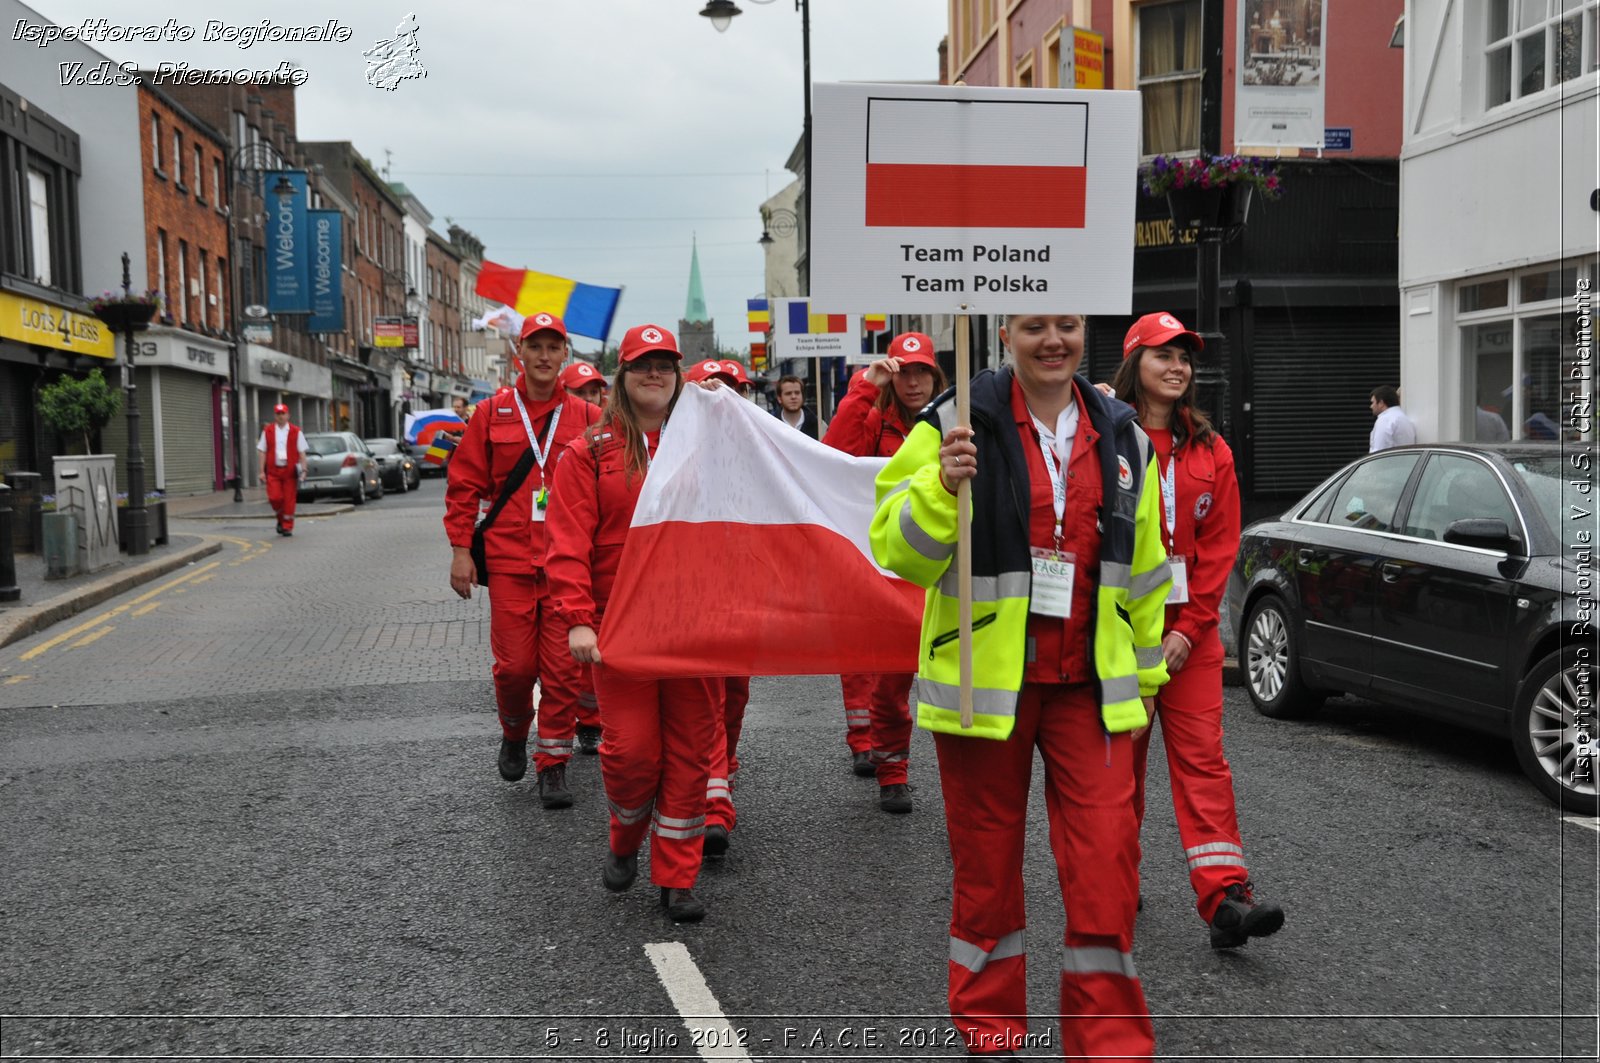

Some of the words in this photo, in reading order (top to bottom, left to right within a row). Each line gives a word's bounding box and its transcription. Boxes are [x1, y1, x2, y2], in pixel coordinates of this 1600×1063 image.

[276, 194, 294, 271] Welcom
[315, 218, 331, 296] Welcome
[900, 244, 964, 262] Team
[972, 244, 1051, 263] Poland
[901, 275, 965, 292] Team
[973, 274, 1049, 293] Polska
[22, 307, 57, 334] LOTS
[57, 311, 72, 346] 4
[72, 319, 99, 343] LESS
